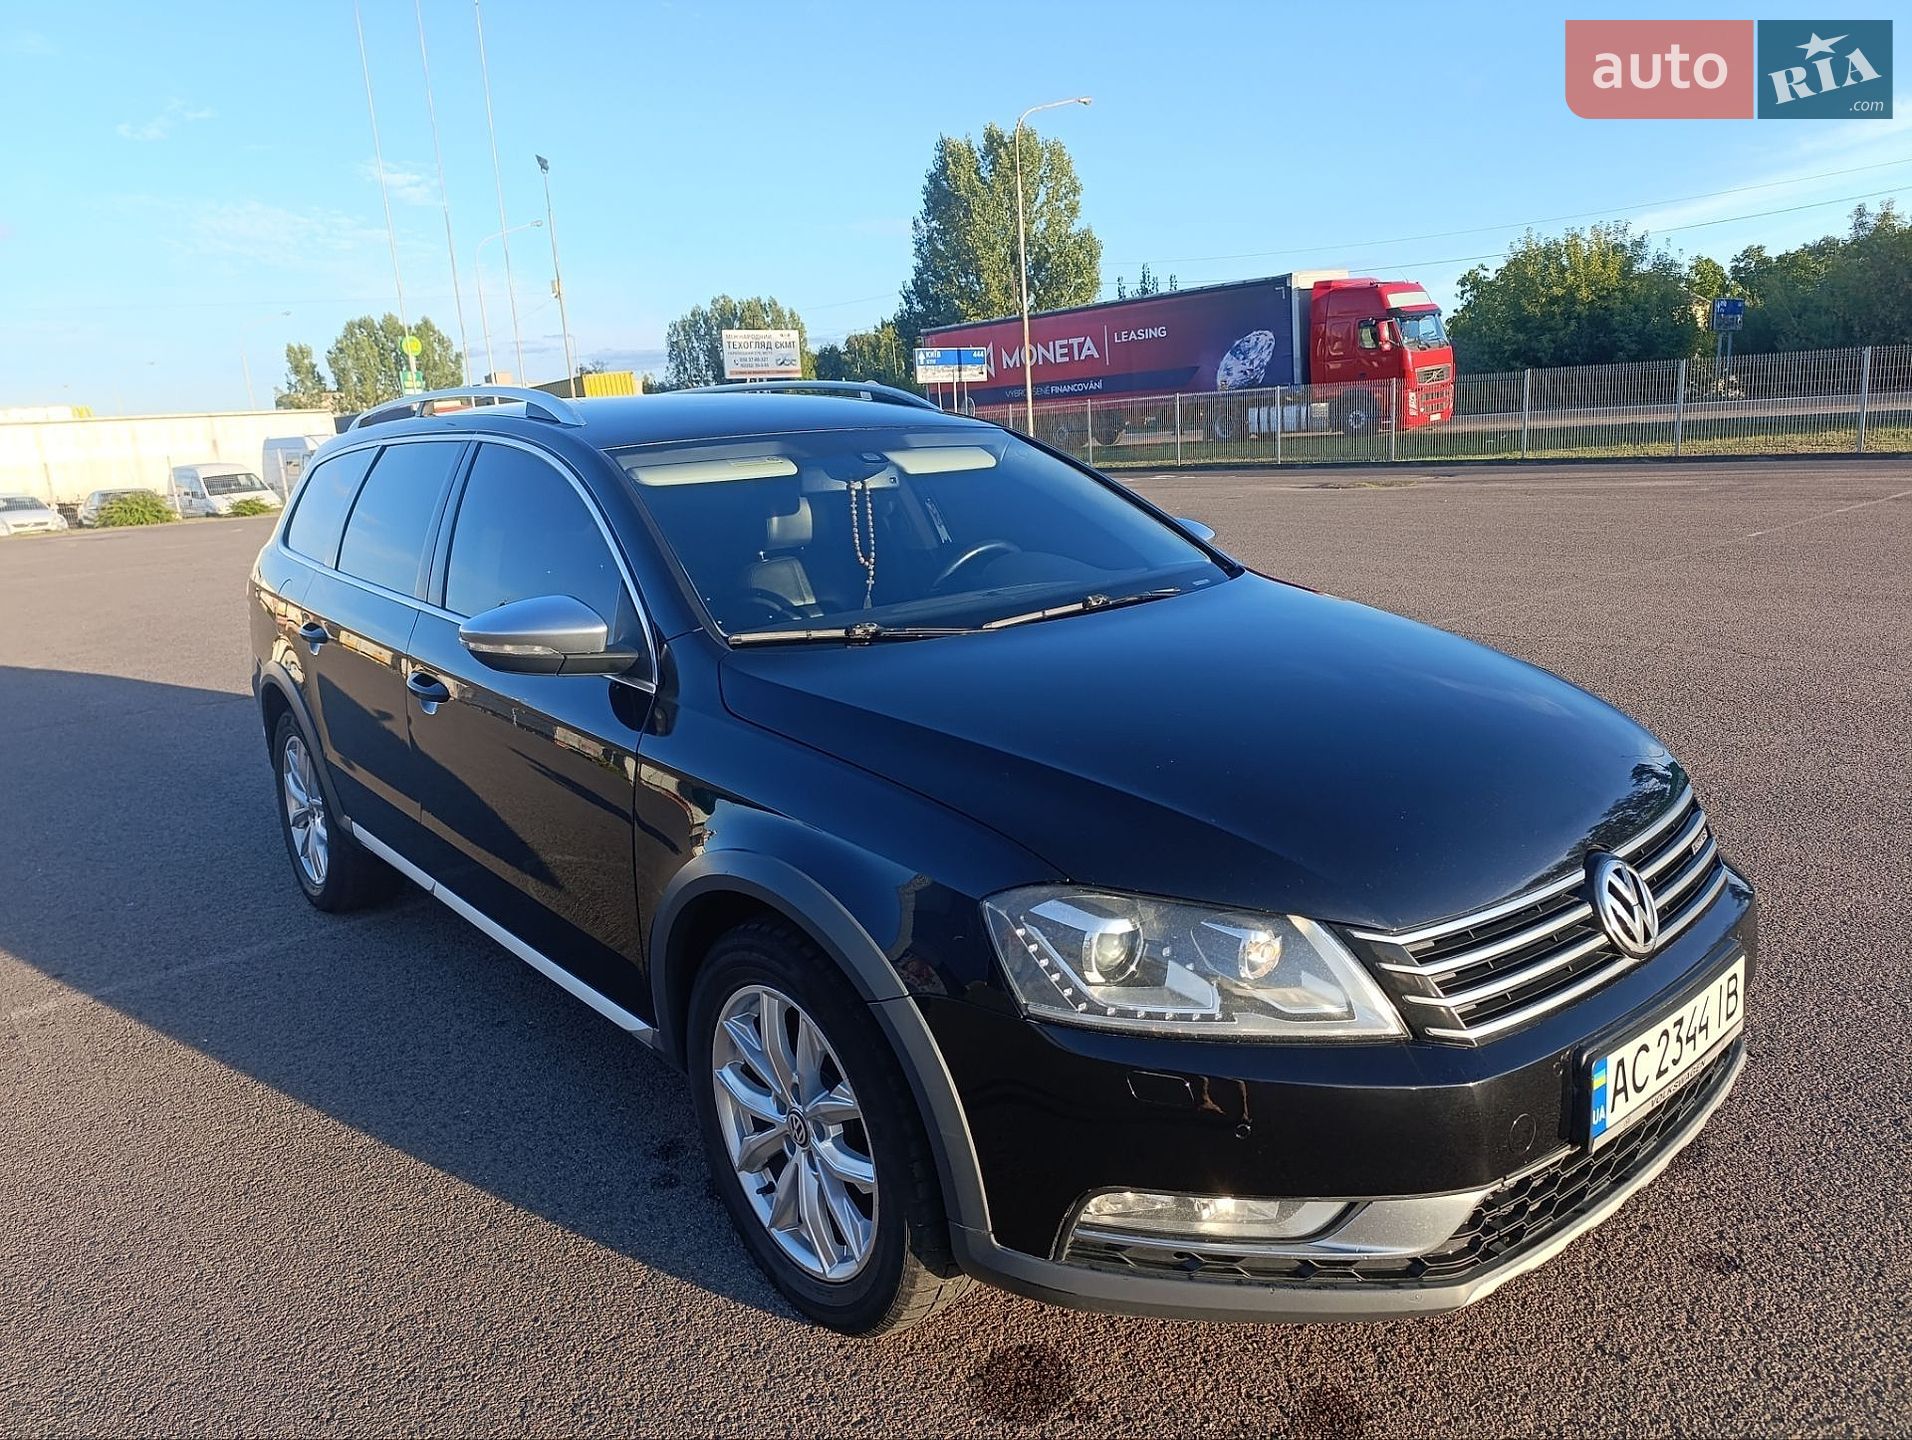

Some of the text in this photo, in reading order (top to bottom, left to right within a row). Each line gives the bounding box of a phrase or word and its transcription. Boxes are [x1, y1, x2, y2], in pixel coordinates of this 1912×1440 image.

[1114, 326, 1168, 343] LEASING
[726, 340, 773, 350] ТЕХОГЛЯД
[1001, 336, 1100, 370] MONETA
[1050, 379, 1103, 395] FINANCOVÁNÍ
[1610, 972, 1739, 1113] AC 2344 IB
[1650, 1059, 1706, 1108] VOLKSWAGEN
[1592, 1106, 1606, 1125] UA
